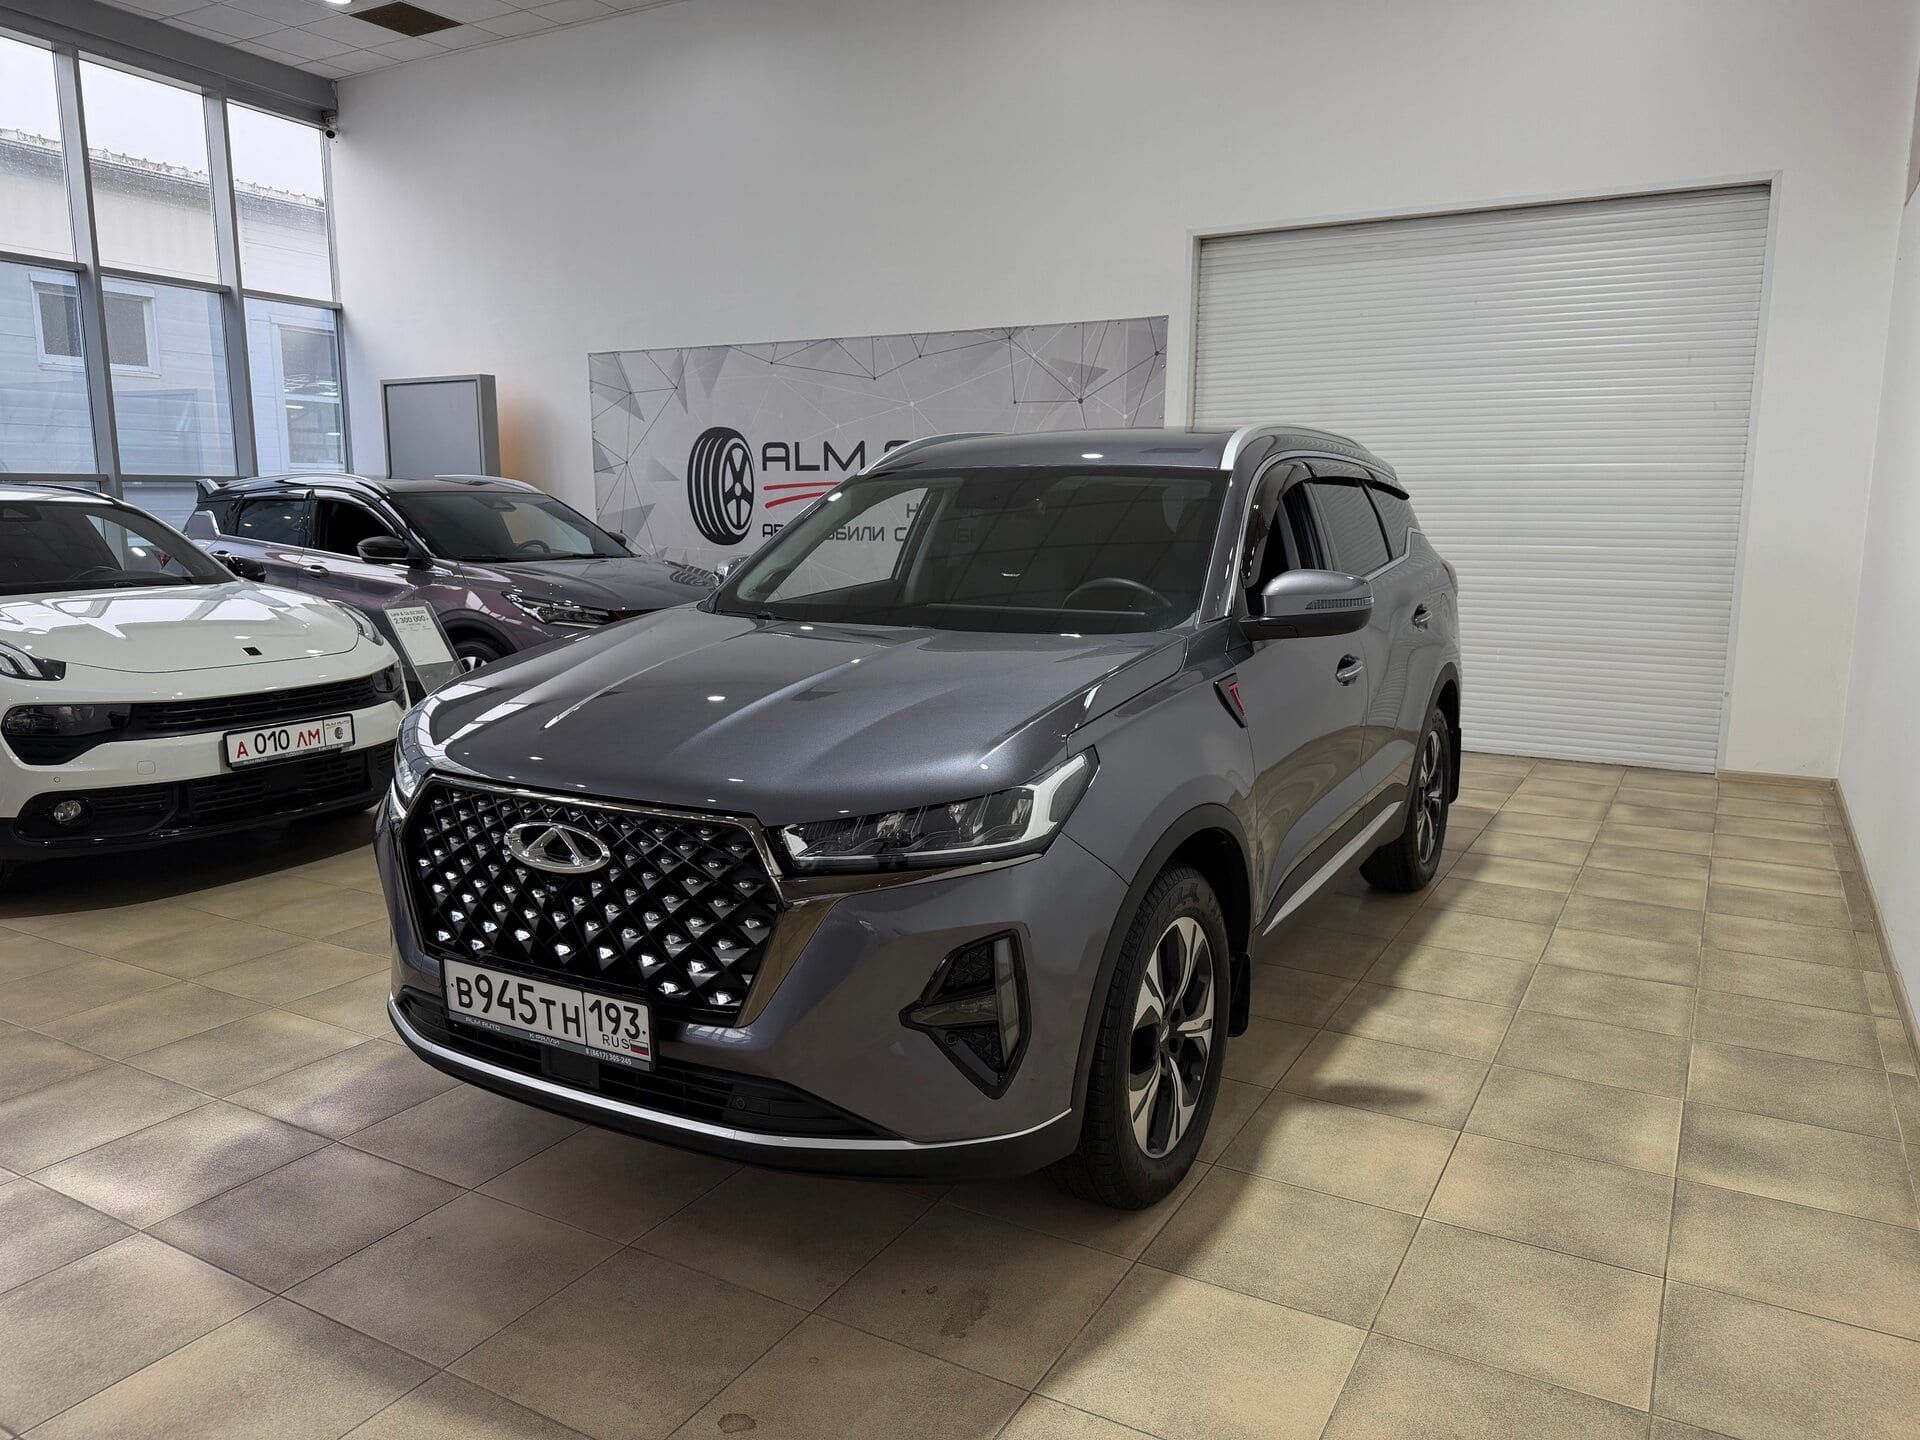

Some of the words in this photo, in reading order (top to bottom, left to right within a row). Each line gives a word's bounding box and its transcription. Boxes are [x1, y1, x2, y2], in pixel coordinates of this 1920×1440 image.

[762, 441, 865, 471] ALM
[254, 729, 290, 754] 010
[588, 999, 640, 1040] 193
[602, 1034, 630, 1050] RUS
